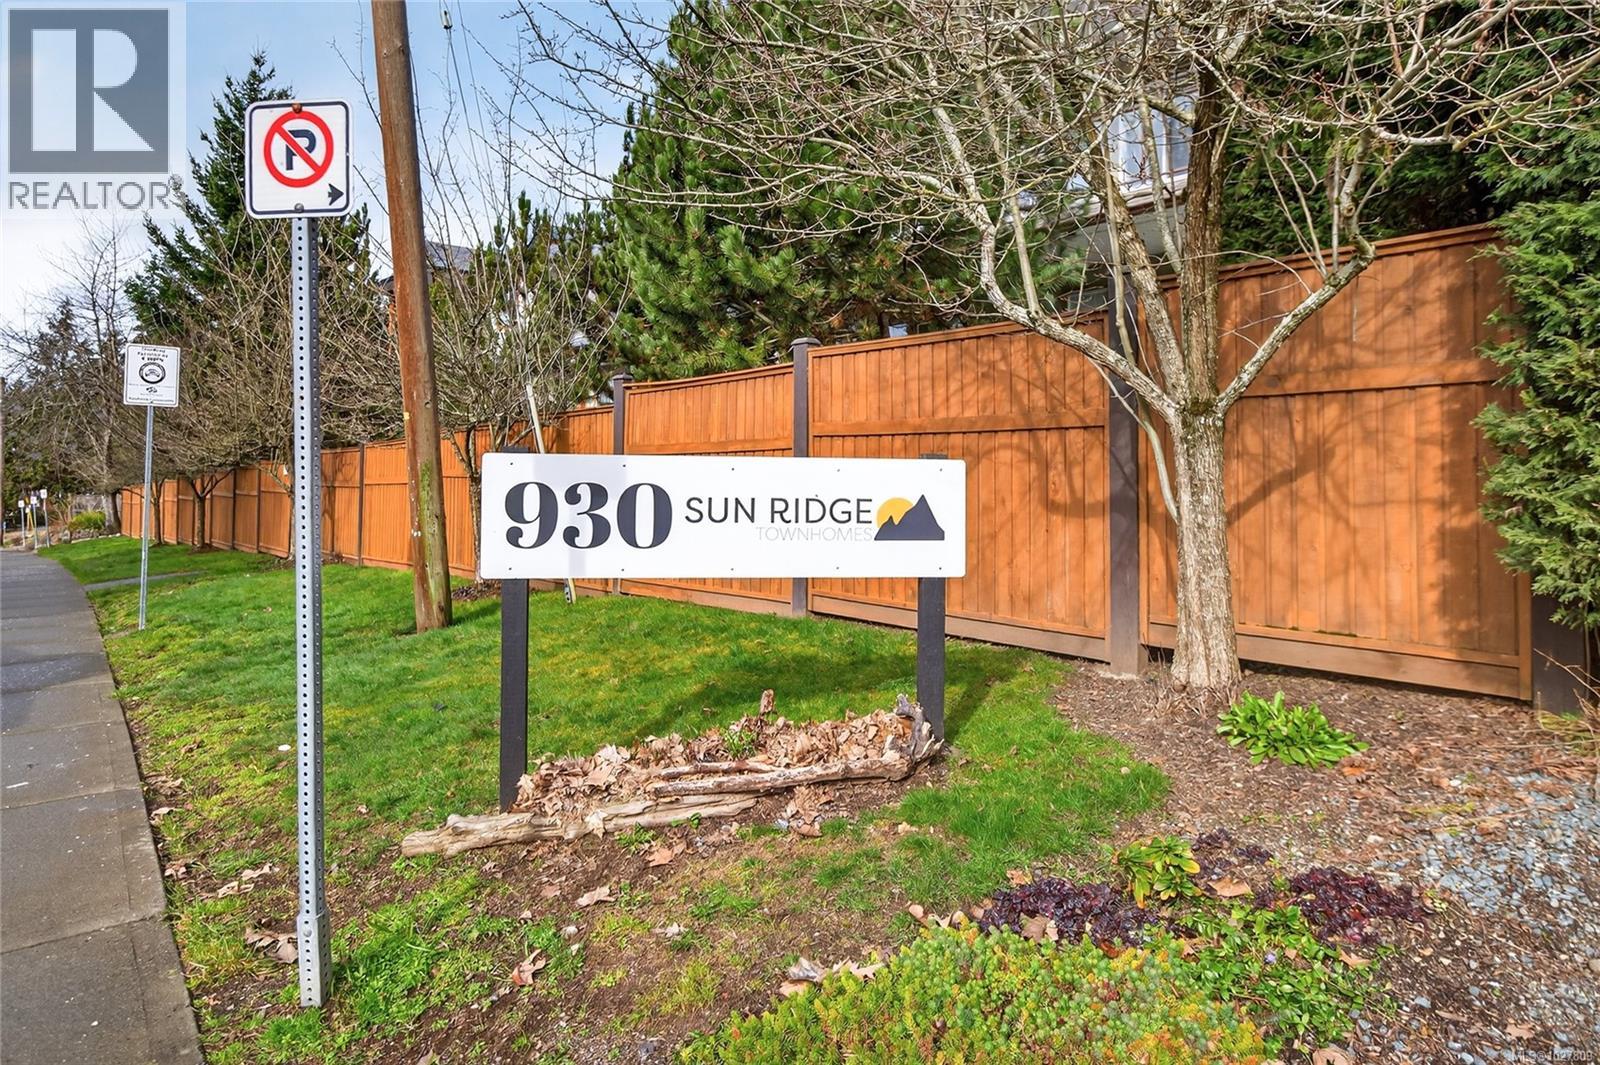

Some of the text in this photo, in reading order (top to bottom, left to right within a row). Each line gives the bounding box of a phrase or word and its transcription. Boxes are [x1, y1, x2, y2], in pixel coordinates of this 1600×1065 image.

[285, 129, 317, 171] P
[505, 482, 672, 549] 930
[685, 497, 873, 524] SUN RIDGE
[756, 527, 873, 541] TOWNHOMES
